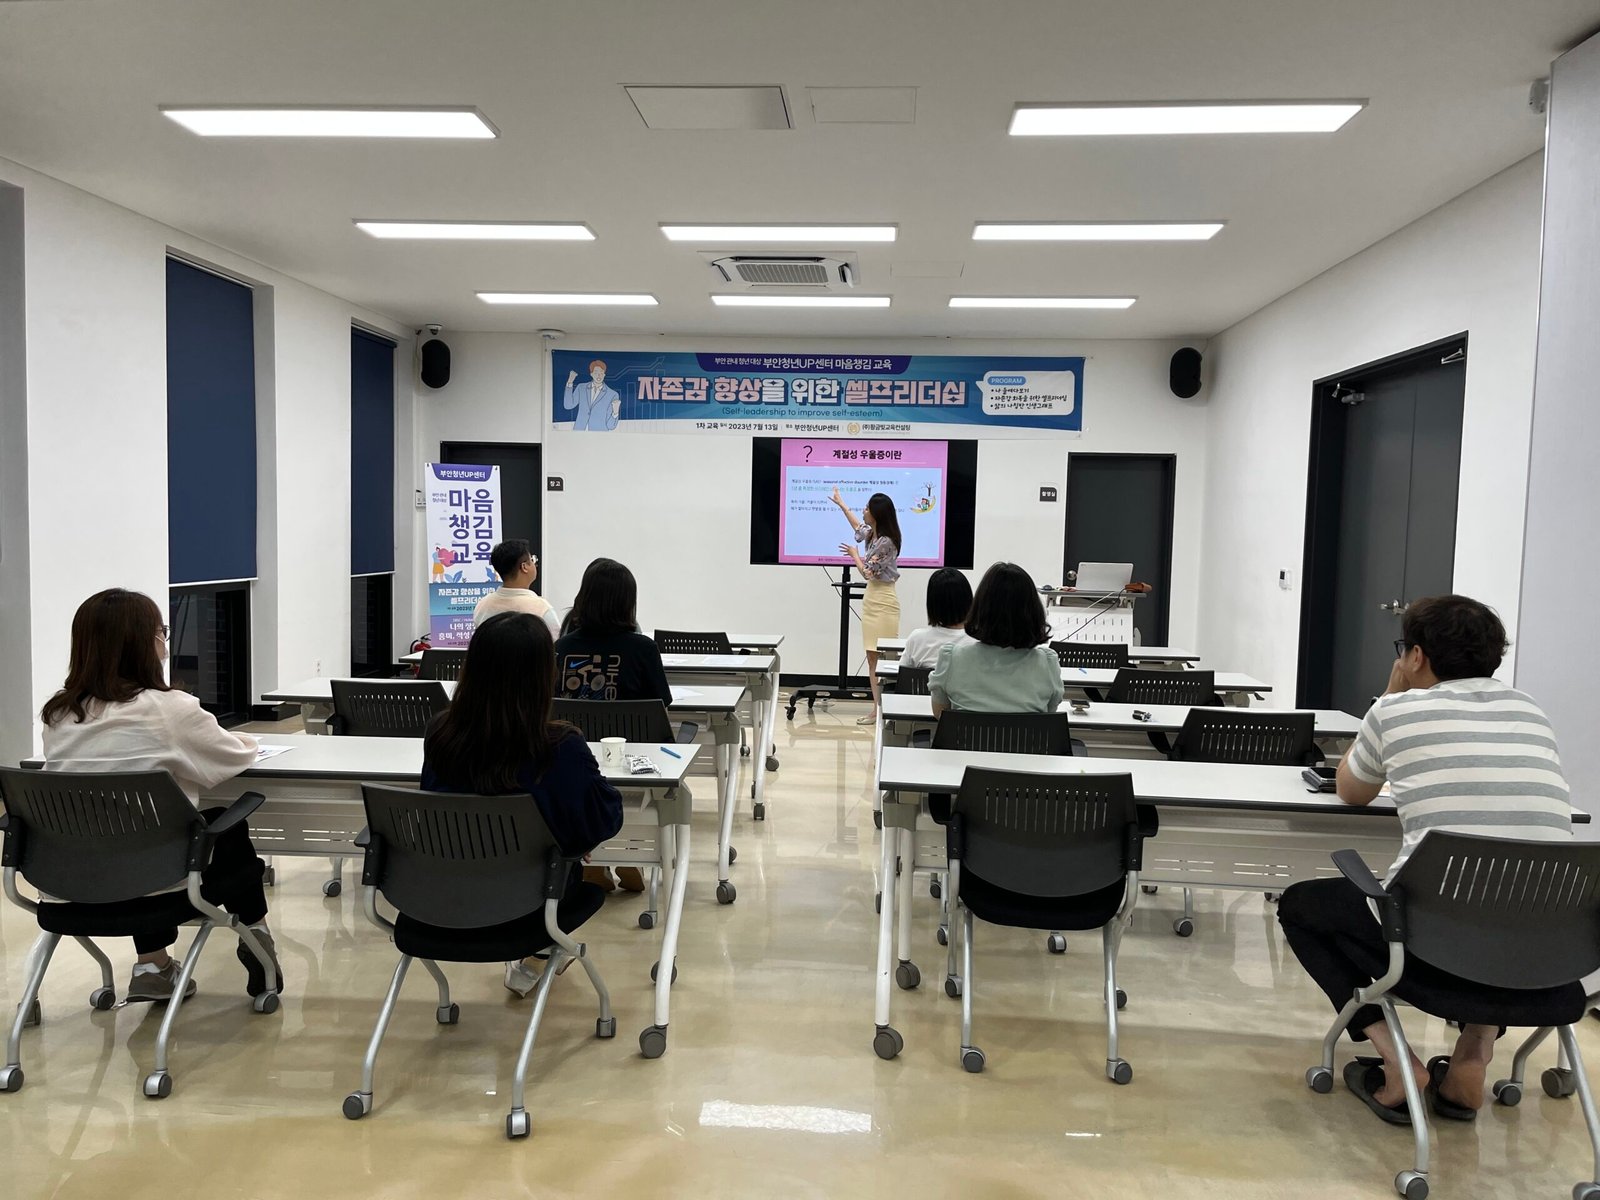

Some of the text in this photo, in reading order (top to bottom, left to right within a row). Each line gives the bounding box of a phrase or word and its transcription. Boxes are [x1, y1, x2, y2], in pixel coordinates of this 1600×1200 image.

[763, 358, 833, 369] 부안청년UP센터
[835, 359, 872, 370] 마음챙김
[873, 359, 892, 370] 교육
[637, 376, 709, 402] 자존감
[714, 376, 786, 404] 향상을
[791, 378, 841, 405] 위한
[722, 407, 883, 418] (Self-leadership to improve self-esteem)
[696, 422, 706, 430] 1차
[728, 423, 752, 431] 2023년
[753, 423, 763, 431] 7월
[794, 424, 840, 432] 부안청년UP센터
[833, 450, 902, 460] 계절성 우울증이란
[440, 470, 486, 479] 부안청년UP센터
[449, 489, 494, 513] 마음
[449, 514, 493, 539] 챙김
[450, 541, 492, 565] 교육
